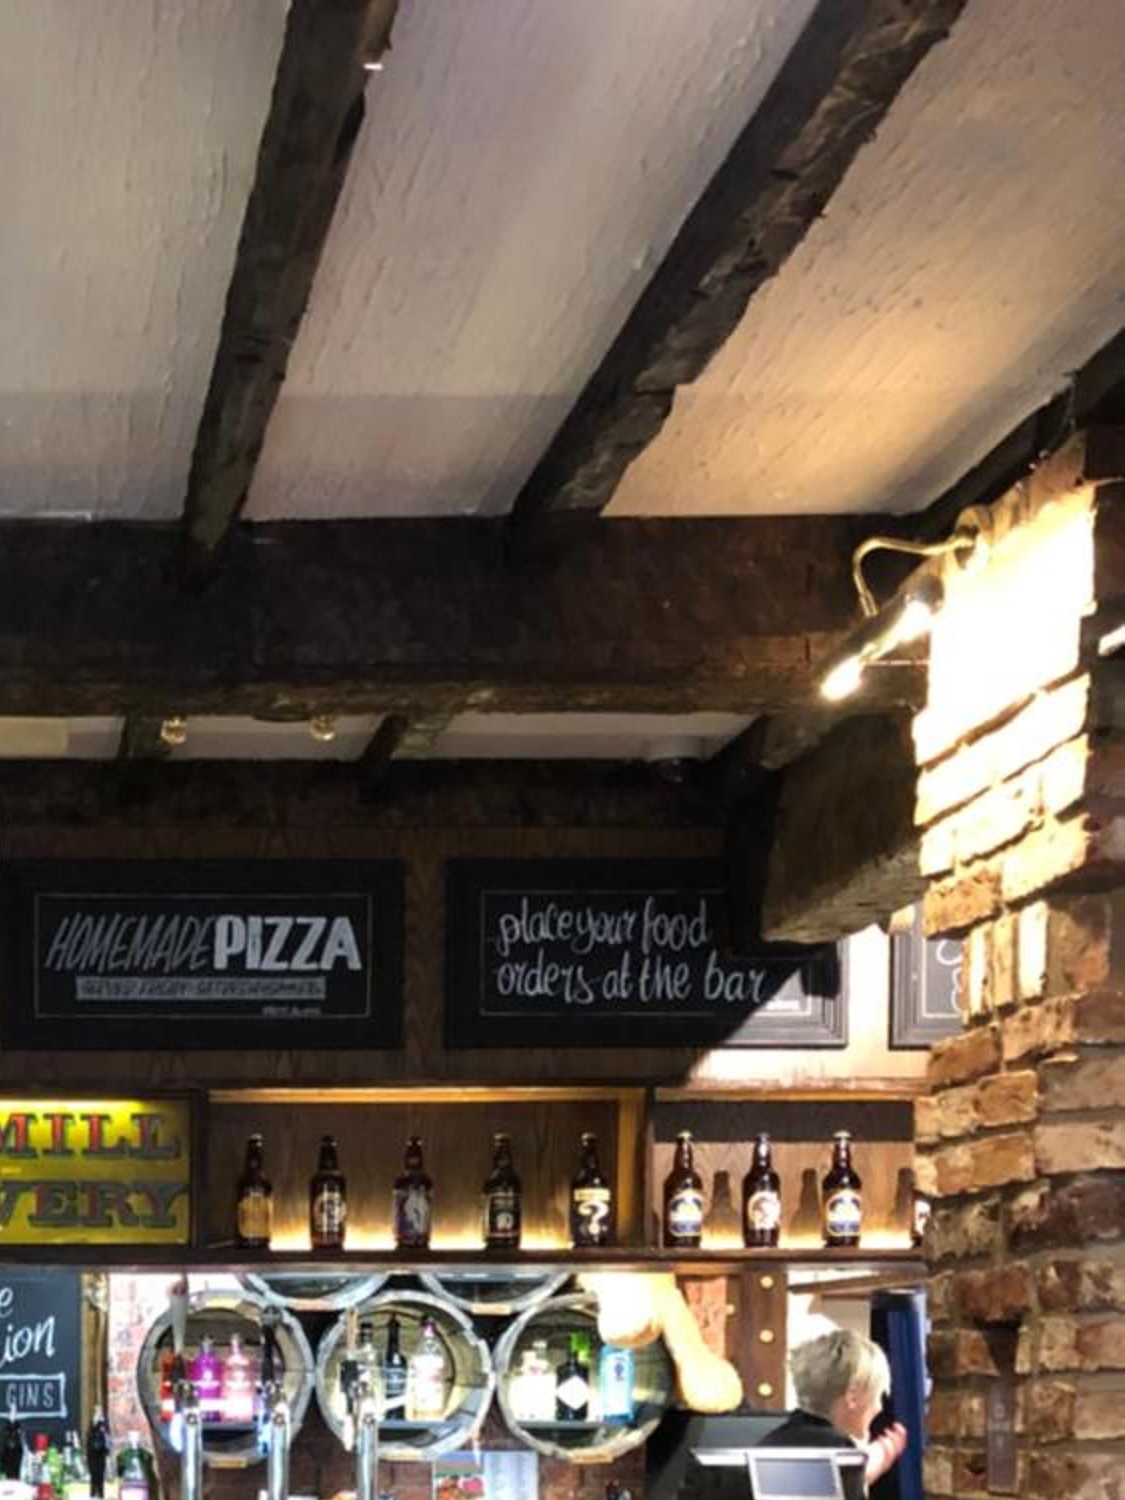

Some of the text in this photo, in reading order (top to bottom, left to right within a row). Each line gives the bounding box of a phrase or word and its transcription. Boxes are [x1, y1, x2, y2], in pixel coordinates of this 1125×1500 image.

[44, 912, 363, 973] HOMEMADE PIZZA
[5, 1383, 55, 1408] GINS
